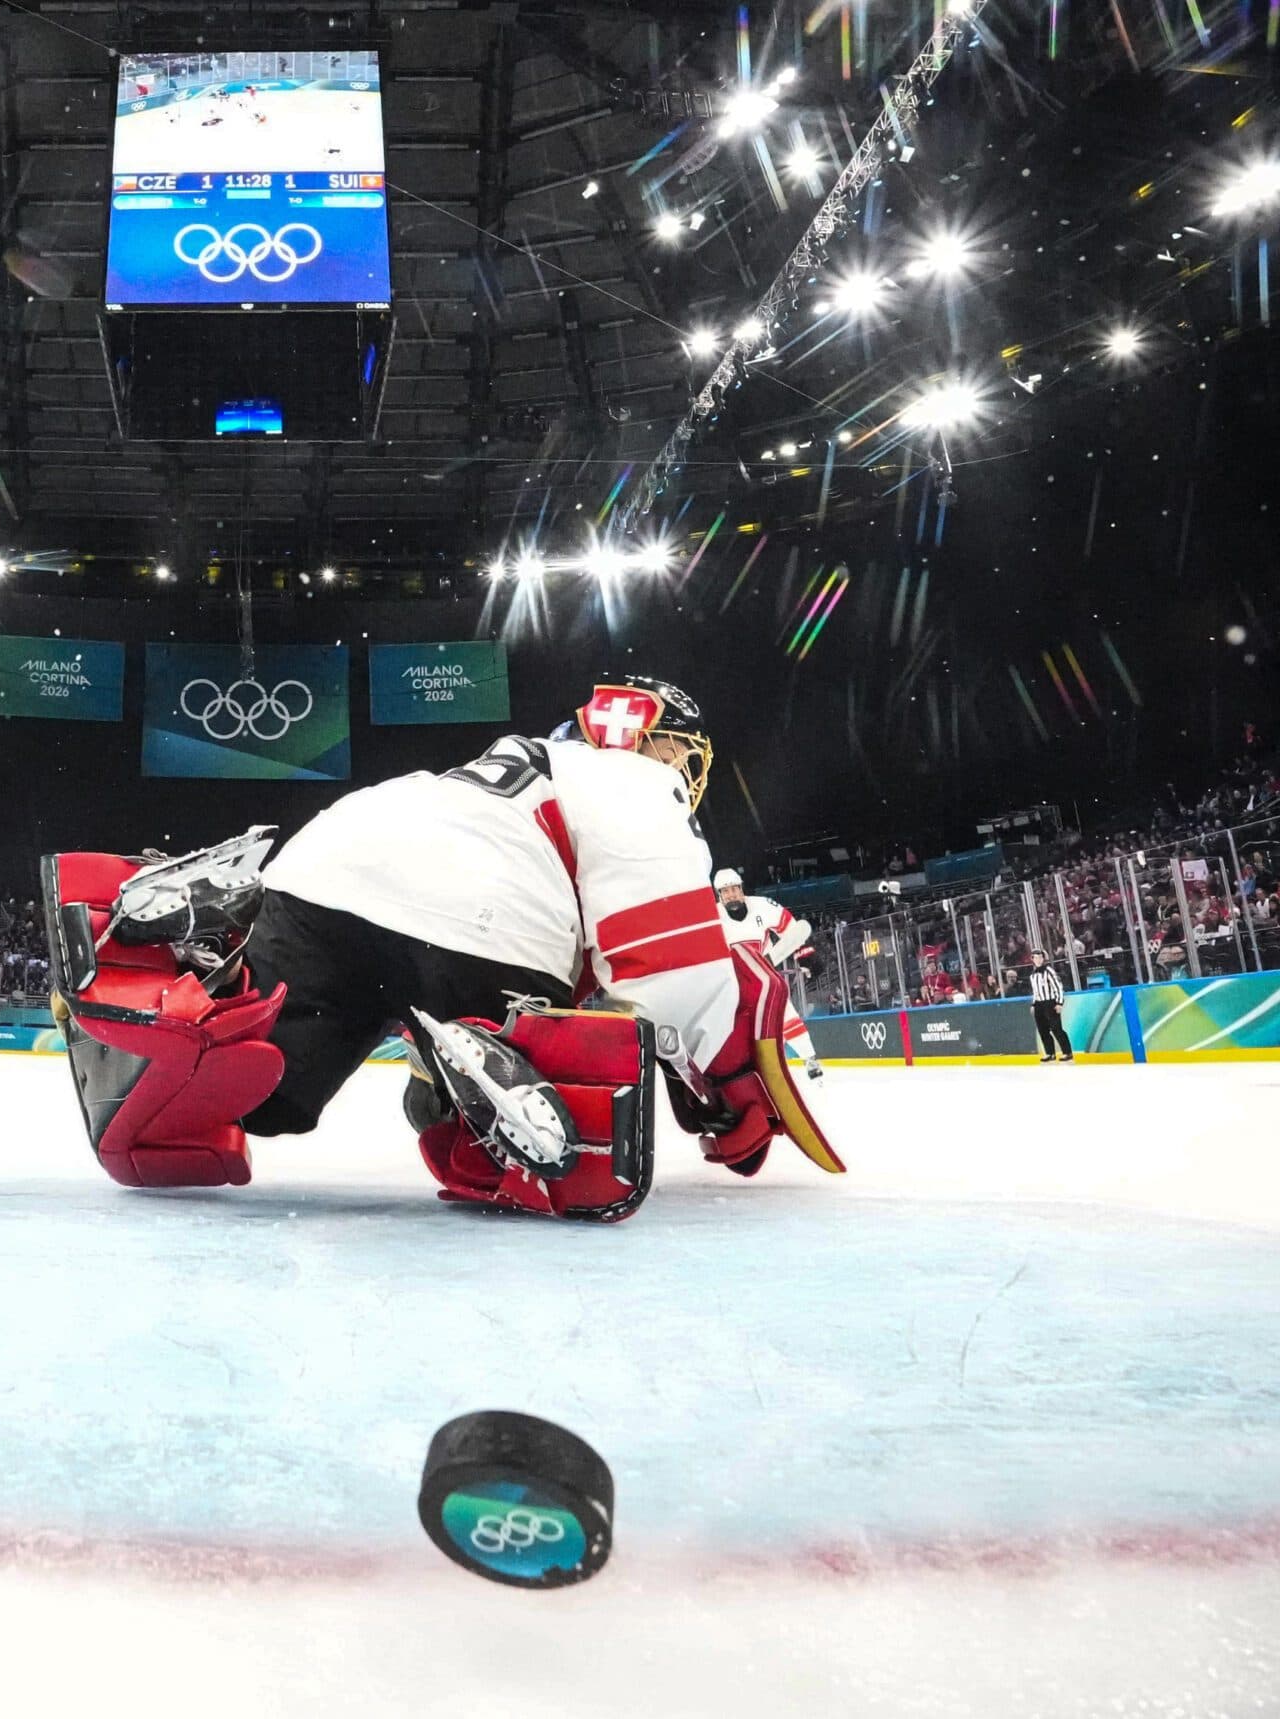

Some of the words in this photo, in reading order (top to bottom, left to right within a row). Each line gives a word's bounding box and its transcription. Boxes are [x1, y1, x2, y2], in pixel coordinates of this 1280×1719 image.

[138, 176, 177, 190] CZE
[201, 176, 213, 189] 1
[225, 174, 272, 188] 11:28
[285, 175, 296, 188] 1
[329, 175, 359, 188] SUI
[19, 659, 82, 673] MILANO
[401, 664, 463, 678] MILANO
[29, 672, 92, 686] CORTINA
[412, 677, 477, 689] CORTINA
[40, 685, 70, 697] 2026
[424, 690, 454, 702] 2026
